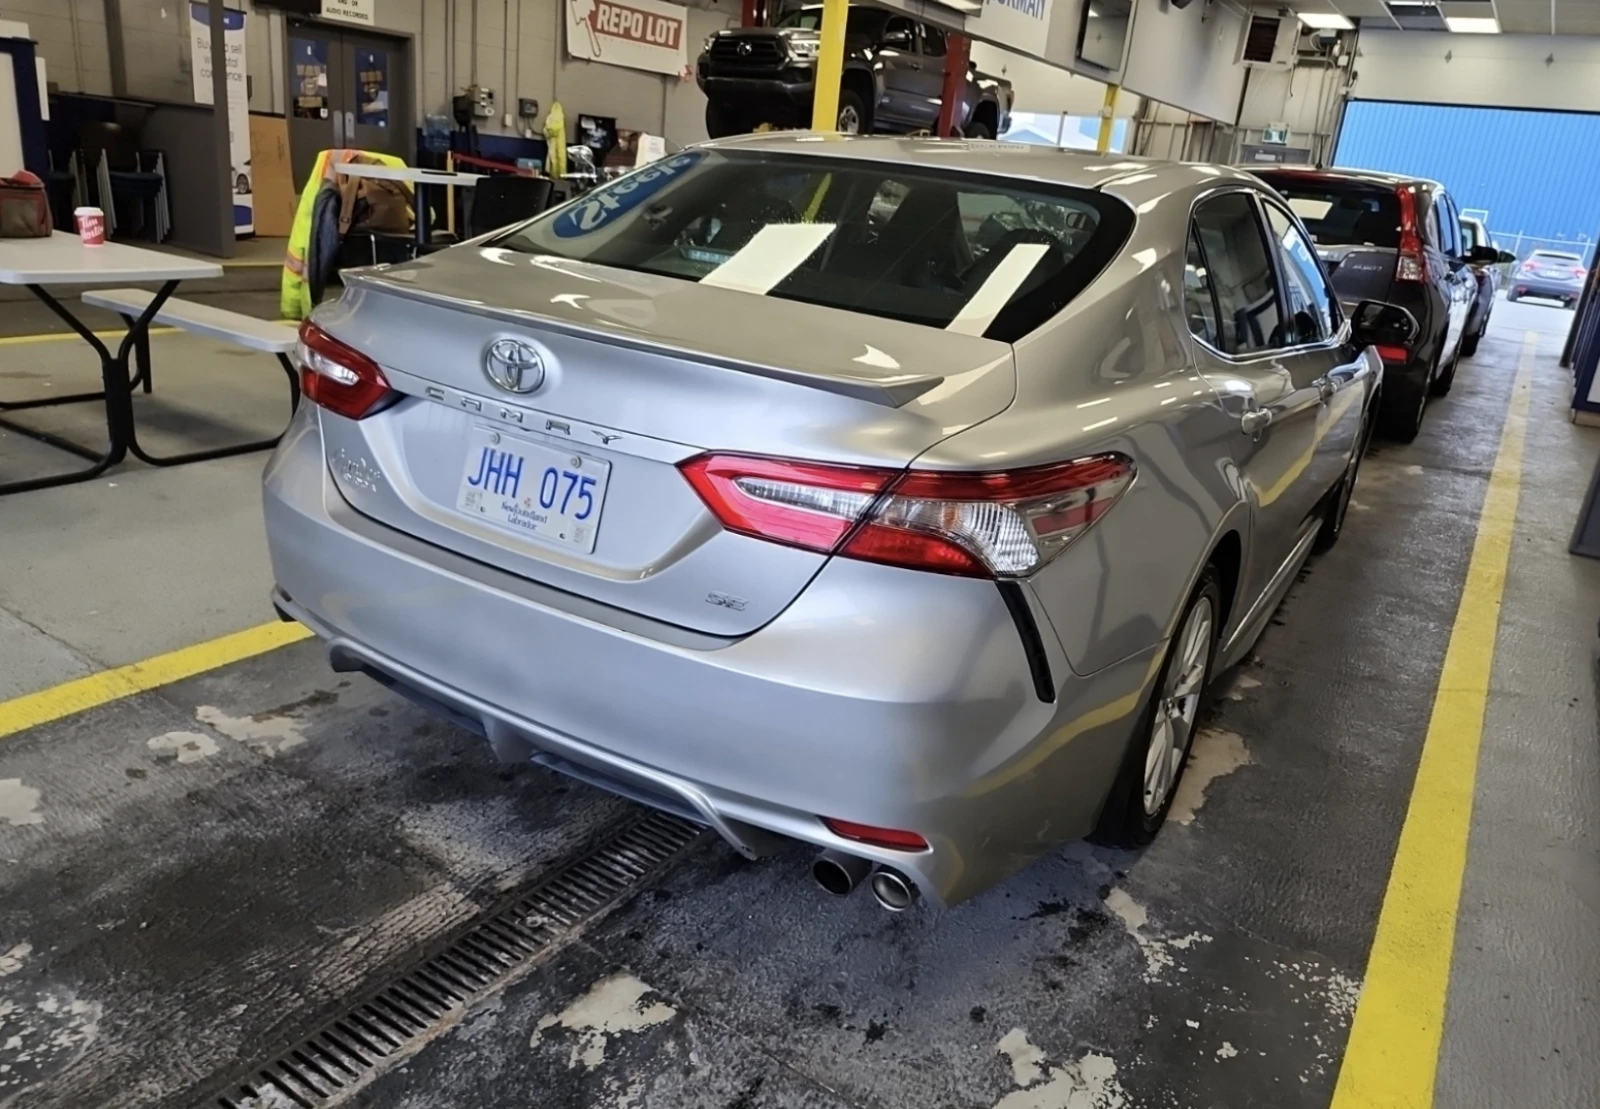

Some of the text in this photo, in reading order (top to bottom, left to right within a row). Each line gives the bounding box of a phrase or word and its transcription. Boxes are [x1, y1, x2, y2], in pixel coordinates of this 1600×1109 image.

[326, 6, 341, 15] AUDIO
[596, 3, 644, 38] REPO
[645, 15, 679, 46] LOT
[196, 37, 212, 51] Bu
[78, 215, 98, 230] Tim
[425, 386, 623, 444] CAMRY
[467, 446, 597, 520] JHH 075
[501, 501, 548, 525] Newfoundland
[507, 515, 538, 531] Labrador
[705, 590, 749, 612] SE
